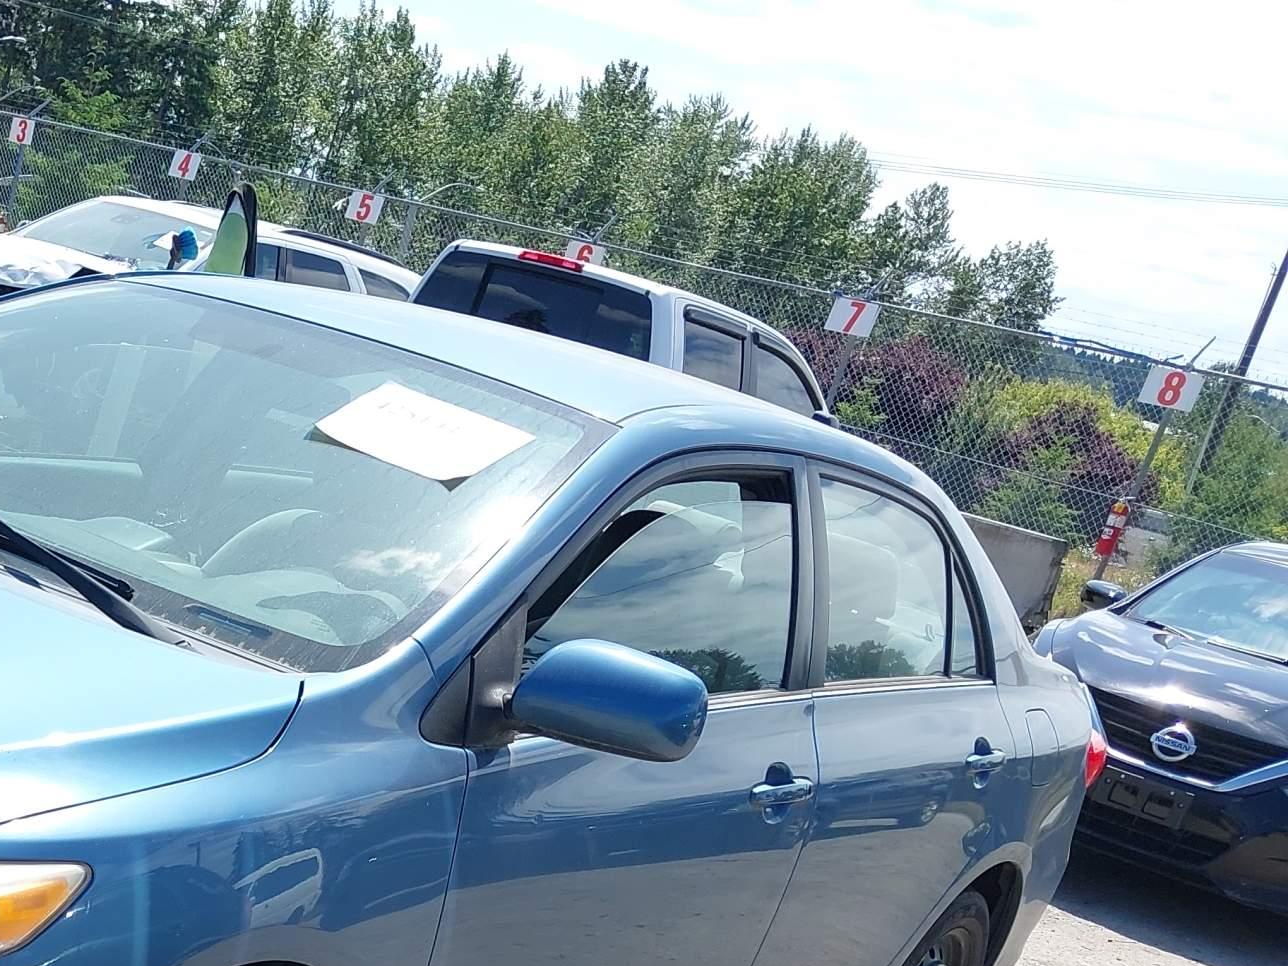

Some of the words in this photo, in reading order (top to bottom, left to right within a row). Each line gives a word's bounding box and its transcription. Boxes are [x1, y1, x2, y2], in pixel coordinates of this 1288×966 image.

[16, 119, 28, 143] 3
[177, 152, 193, 178] 4
[355, 193, 375, 223] 5
[842, 301, 867, 335] 7
[1157, 371, 1187, 406] 8
[1154, 735, 1191, 752] NISSAN
